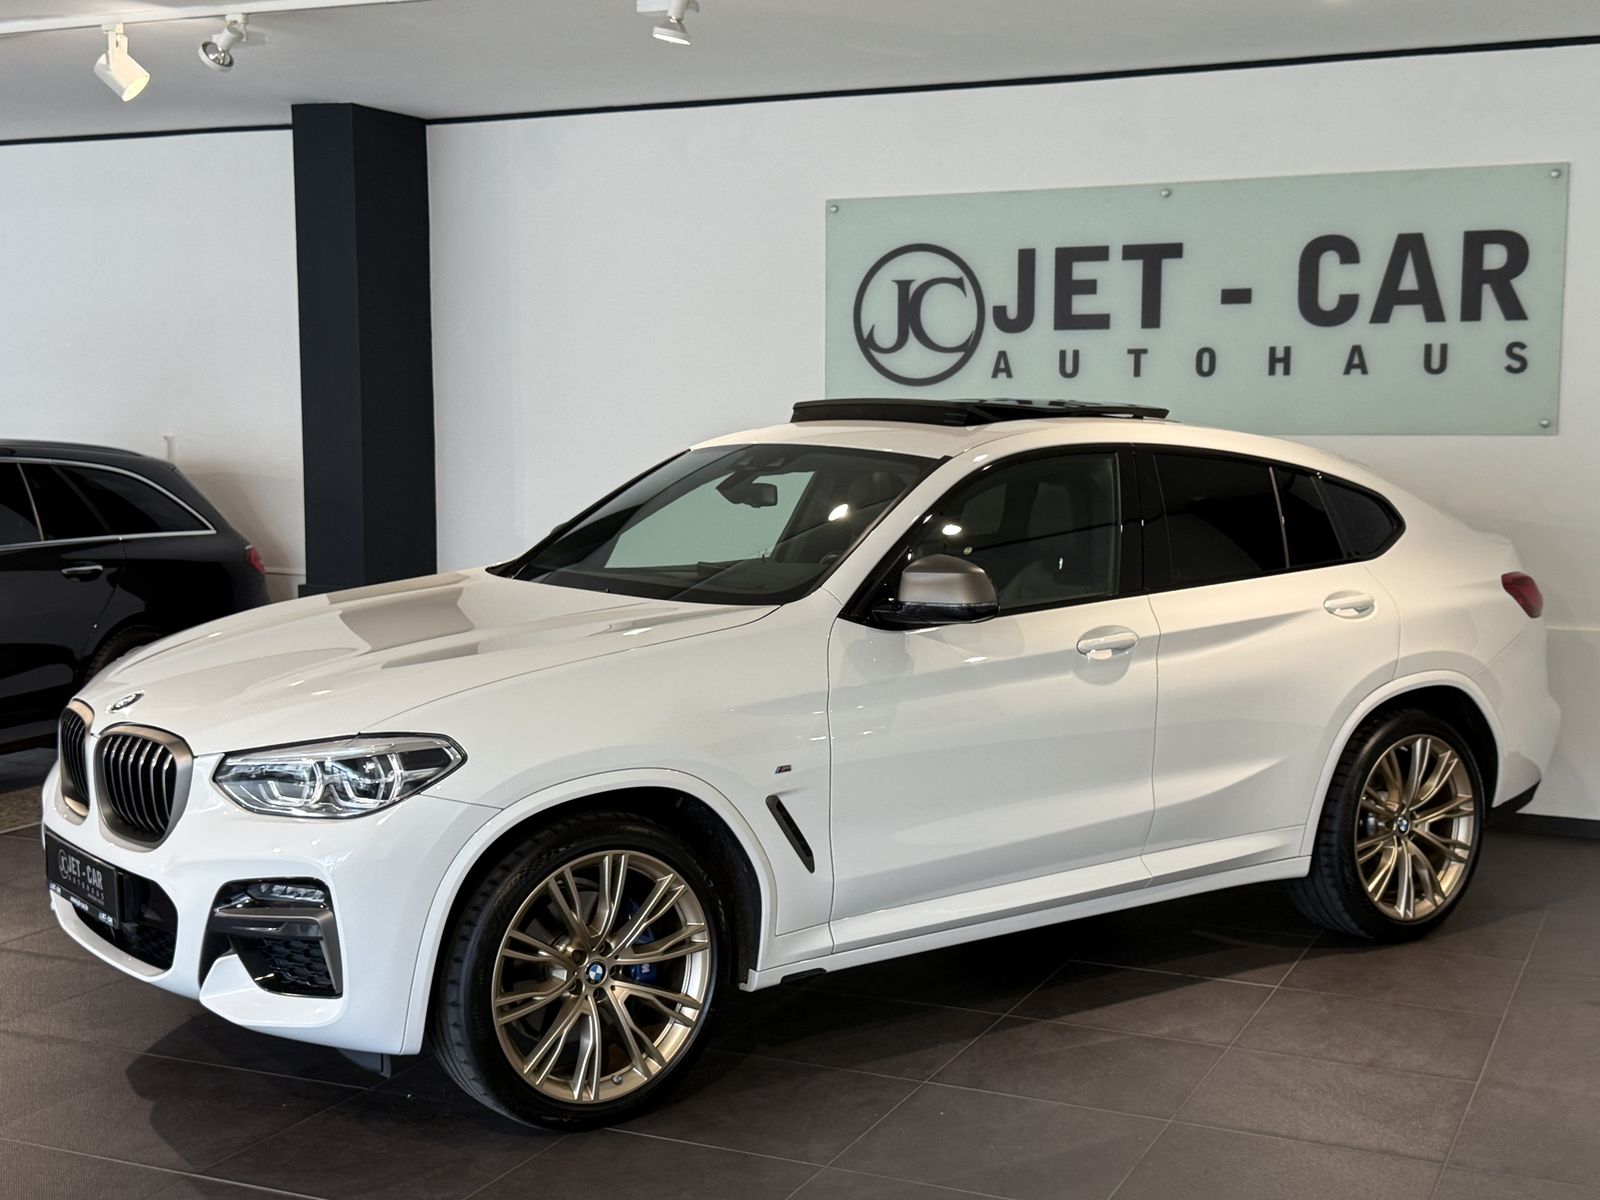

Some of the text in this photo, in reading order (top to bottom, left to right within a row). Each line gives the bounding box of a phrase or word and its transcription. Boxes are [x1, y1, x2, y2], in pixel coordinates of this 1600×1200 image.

[992, 229, 1530, 334] JET - CAR
[863, 276, 975, 354] JC
[991, 341, 1529, 379] AUTOHAUS
[68, 855, 80, 878] JET
[87, 865, 103, 890] CAR
